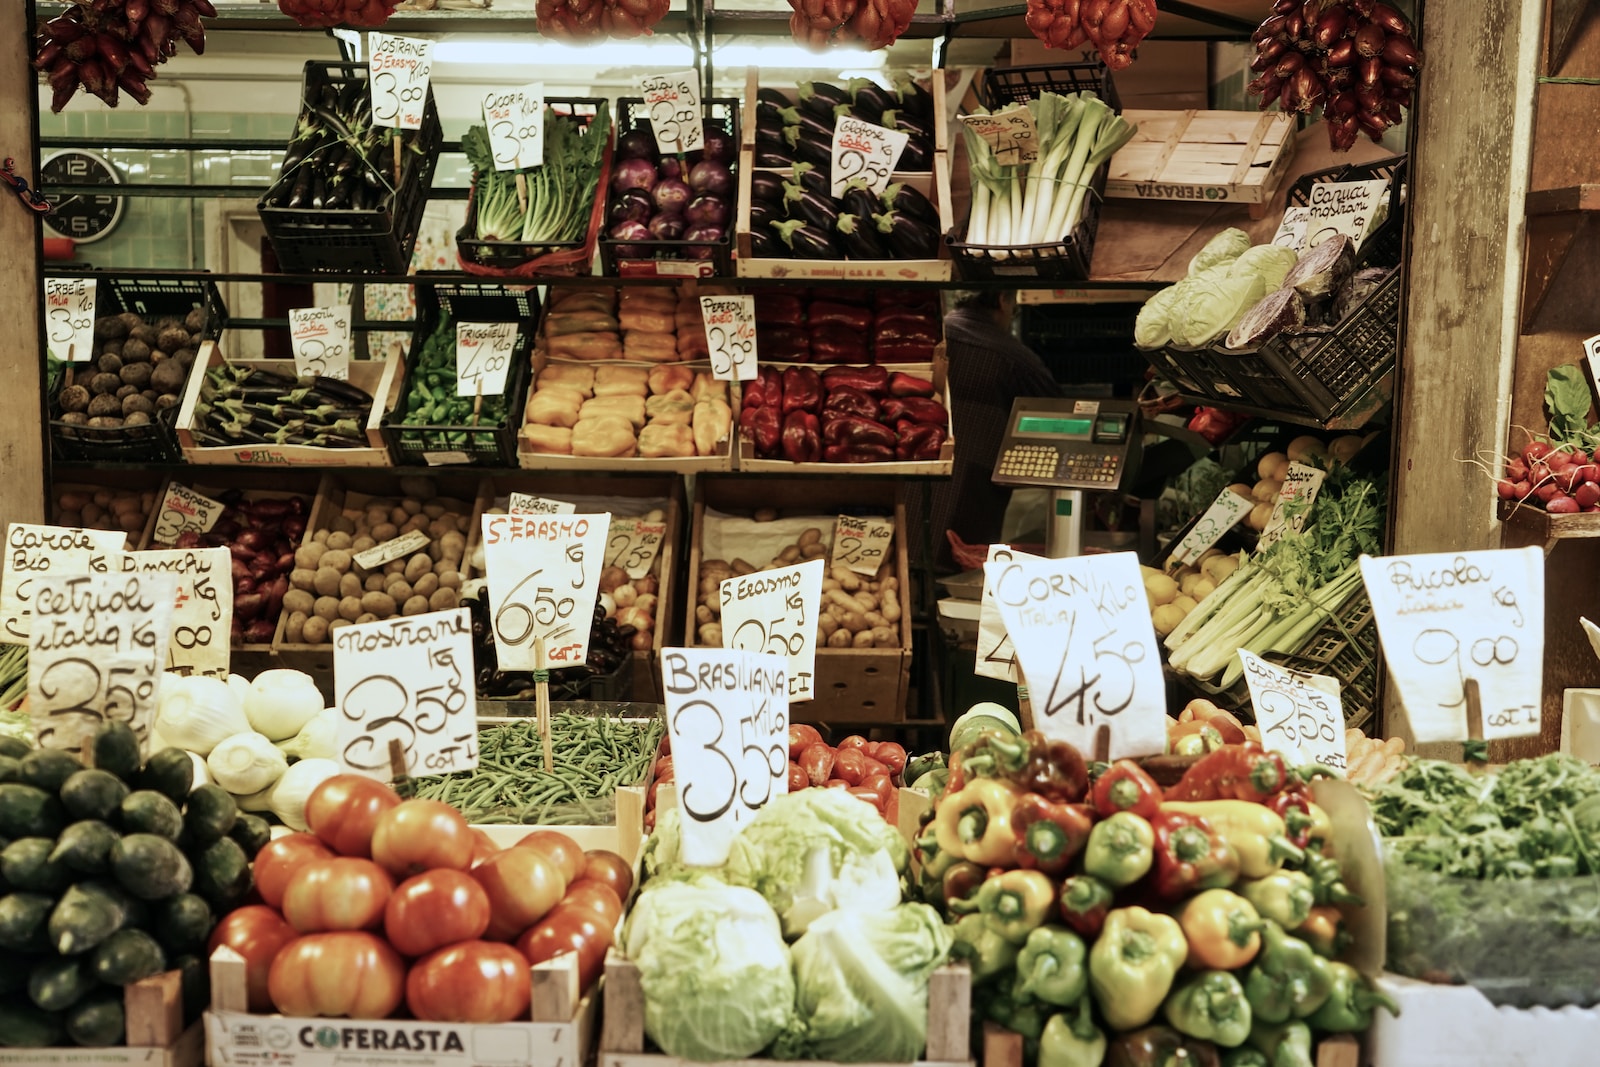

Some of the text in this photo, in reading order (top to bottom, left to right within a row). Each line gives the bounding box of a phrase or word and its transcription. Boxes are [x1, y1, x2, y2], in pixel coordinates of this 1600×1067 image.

[371, 36, 427, 56] NOSTRANE
[67, 160, 87, 176] 12
[72, 216, 88, 232] 6
[47, 279, 86, 296] ERBETTE
[48, 295, 69, 306] ITALIA
[10, 527, 95, 551] Carote
[13, 549, 50, 571] Bio
[565, 543, 585, 589] Kg
[193, 576, 221, 621] Kg
[784, 591, 805, 627] Kg
[1090, 580, 1137, 629] KILO
[1491, 585, 1525, 629] Kg
[1018, 606, 1069, 628] ITALIA
[337, 611, 471, 653] nostrani
[665, 653, 785, 697] BRASILIANA
[299, 1026, 464, 1052] COFERASTA
